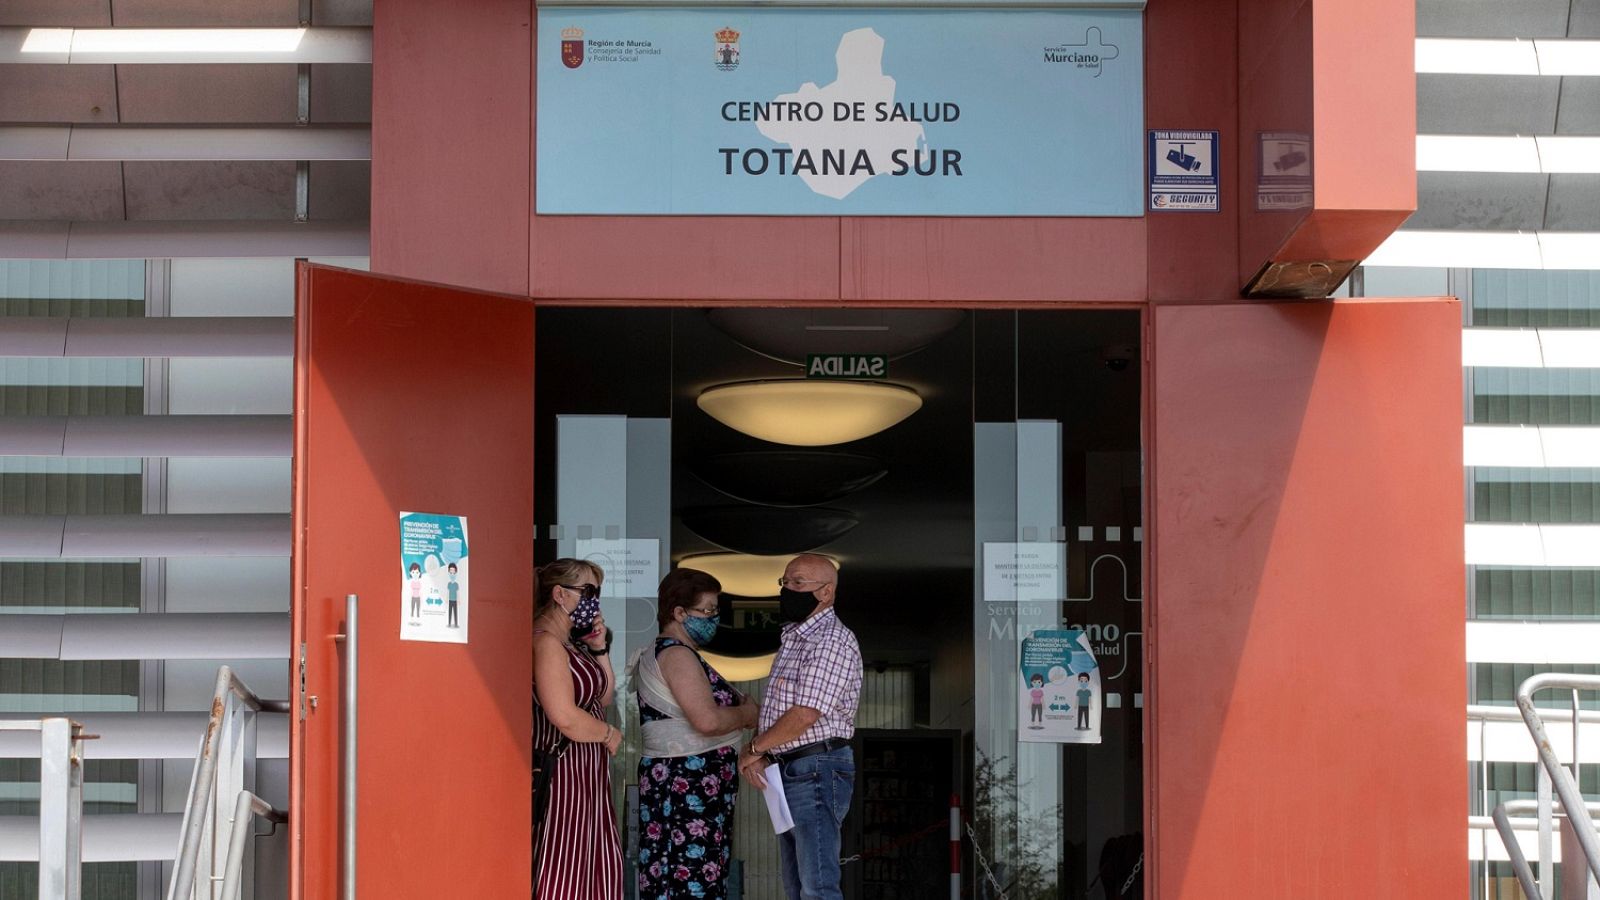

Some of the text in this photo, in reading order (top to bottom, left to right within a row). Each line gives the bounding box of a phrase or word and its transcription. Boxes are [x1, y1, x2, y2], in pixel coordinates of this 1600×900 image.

[588, 40, 614, 48] Región
[1044, 52, 1099, 62] Murciano
[721, 102, 961, 122] CENTRO DE SALUD
[1154, 132, 1213, 140] ZONA VIDEOVIGILADA
[719, 148, 963, 177] TOTANA SUR
[1170, 194, 1215, 204] SECURITY
[988, 604, 1042, 616] Servicio
[1091, 643, 1119, 655] alud
